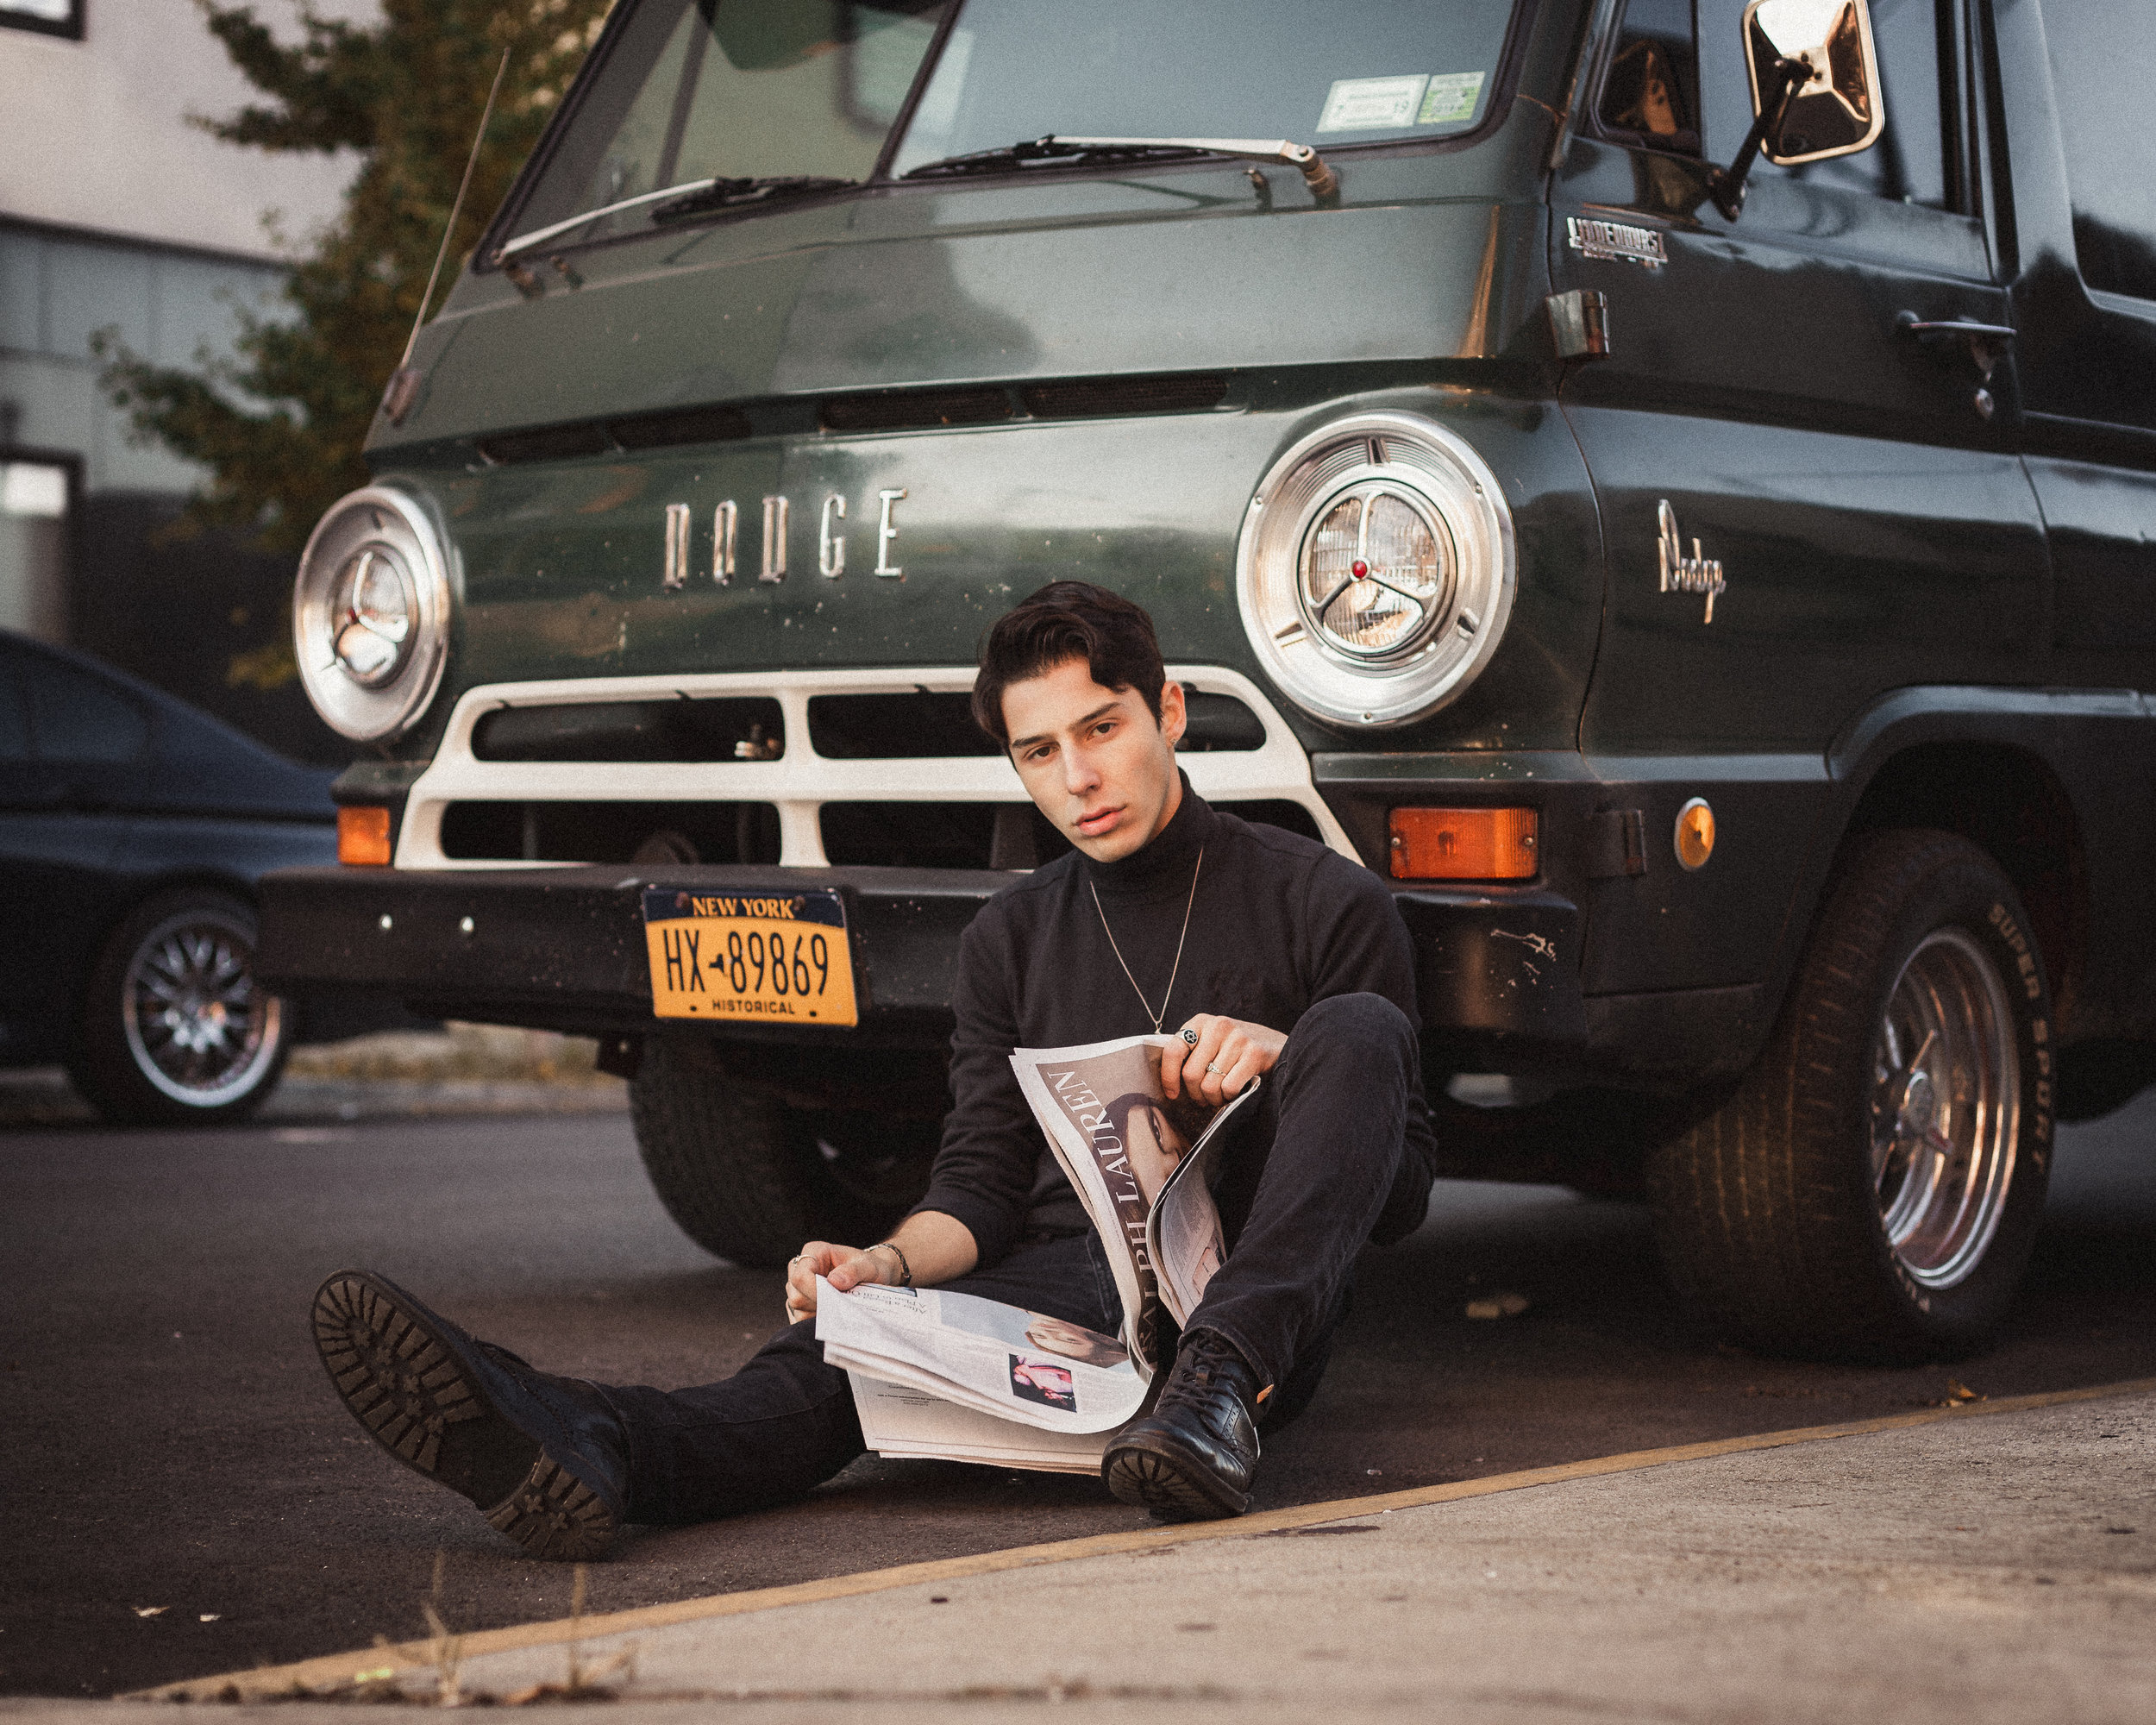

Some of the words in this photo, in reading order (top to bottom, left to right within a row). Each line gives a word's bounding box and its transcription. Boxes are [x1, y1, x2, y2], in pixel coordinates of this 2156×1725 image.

[661, 487, 907, 589] DODGE
[691, 896, 738, 917] NEW
[741, 898, 795, 920] YORK
[663, 929, 706, 993] HX
[728, 930, 829, 997] 89869
[711, 998, 796, 1015] HISTORICAL
[1988, 904, 2040, 1000] SUPER
[2032, 1018, 2050, 1174] SPORT
[1046, 1070, 1140, 1204] LAUREN
